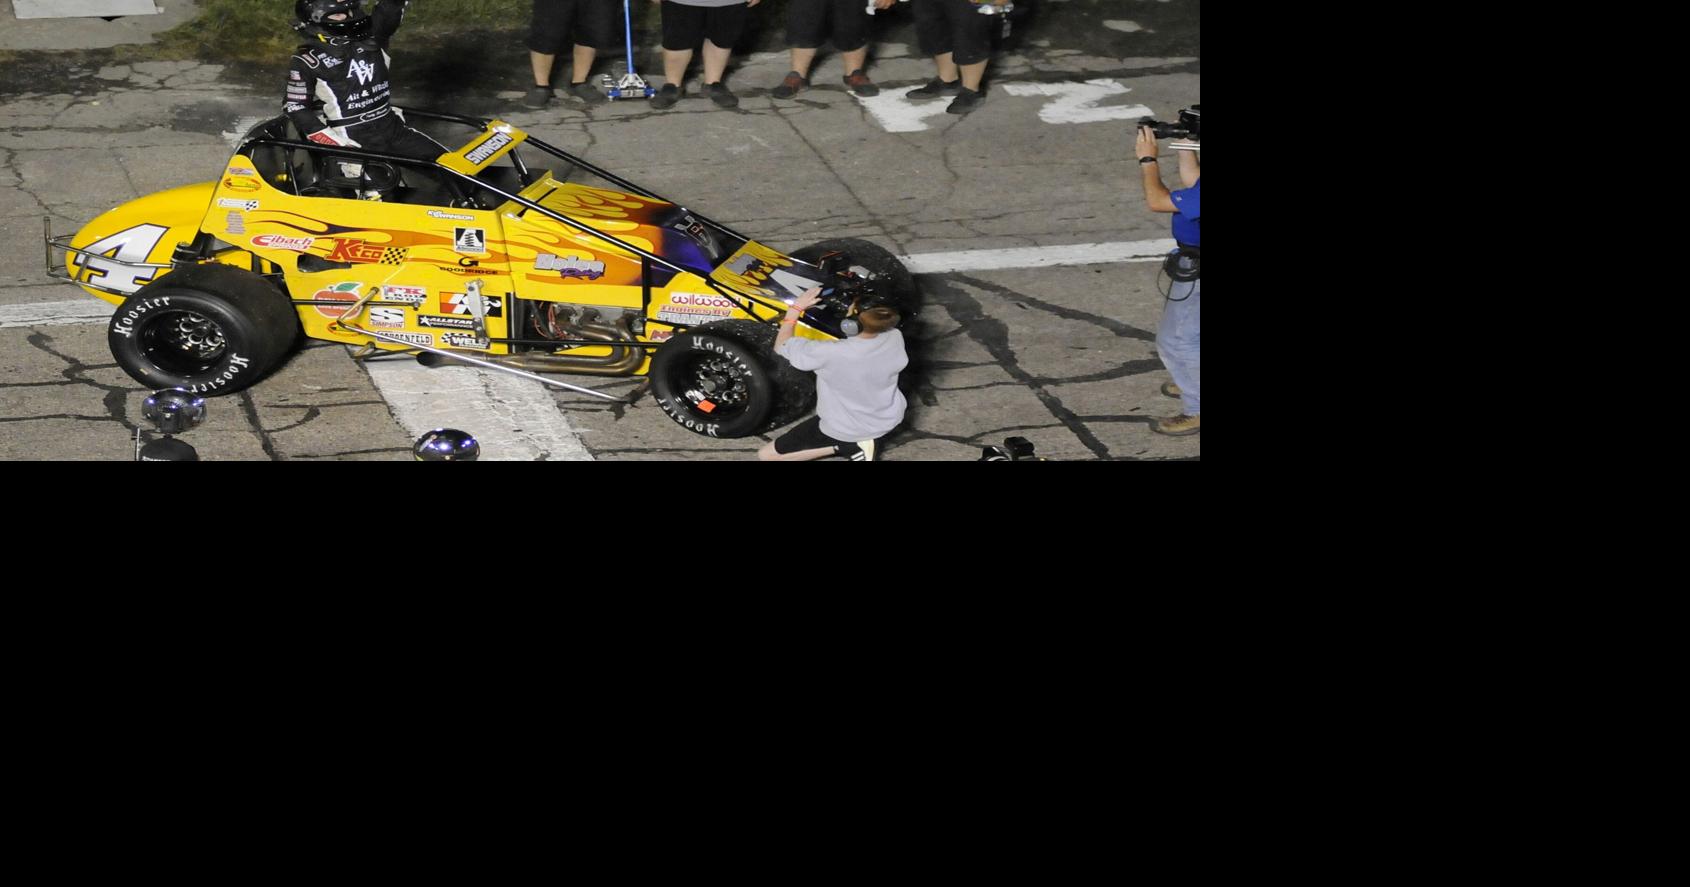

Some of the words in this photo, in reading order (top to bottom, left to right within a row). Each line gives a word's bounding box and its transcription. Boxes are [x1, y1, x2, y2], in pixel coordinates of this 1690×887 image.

[464, 132, 513, 165] SWANSON
[73, 222, 171, 296] 4
[252, 235, 312, 248] Eibach
[113, 294, 171, 338] Hoosier
[429, 317, 473, 325] ALLSTAR
[691, 336, 753, 377] Hoosier
[657, 398, 720, 437] Hoosier
